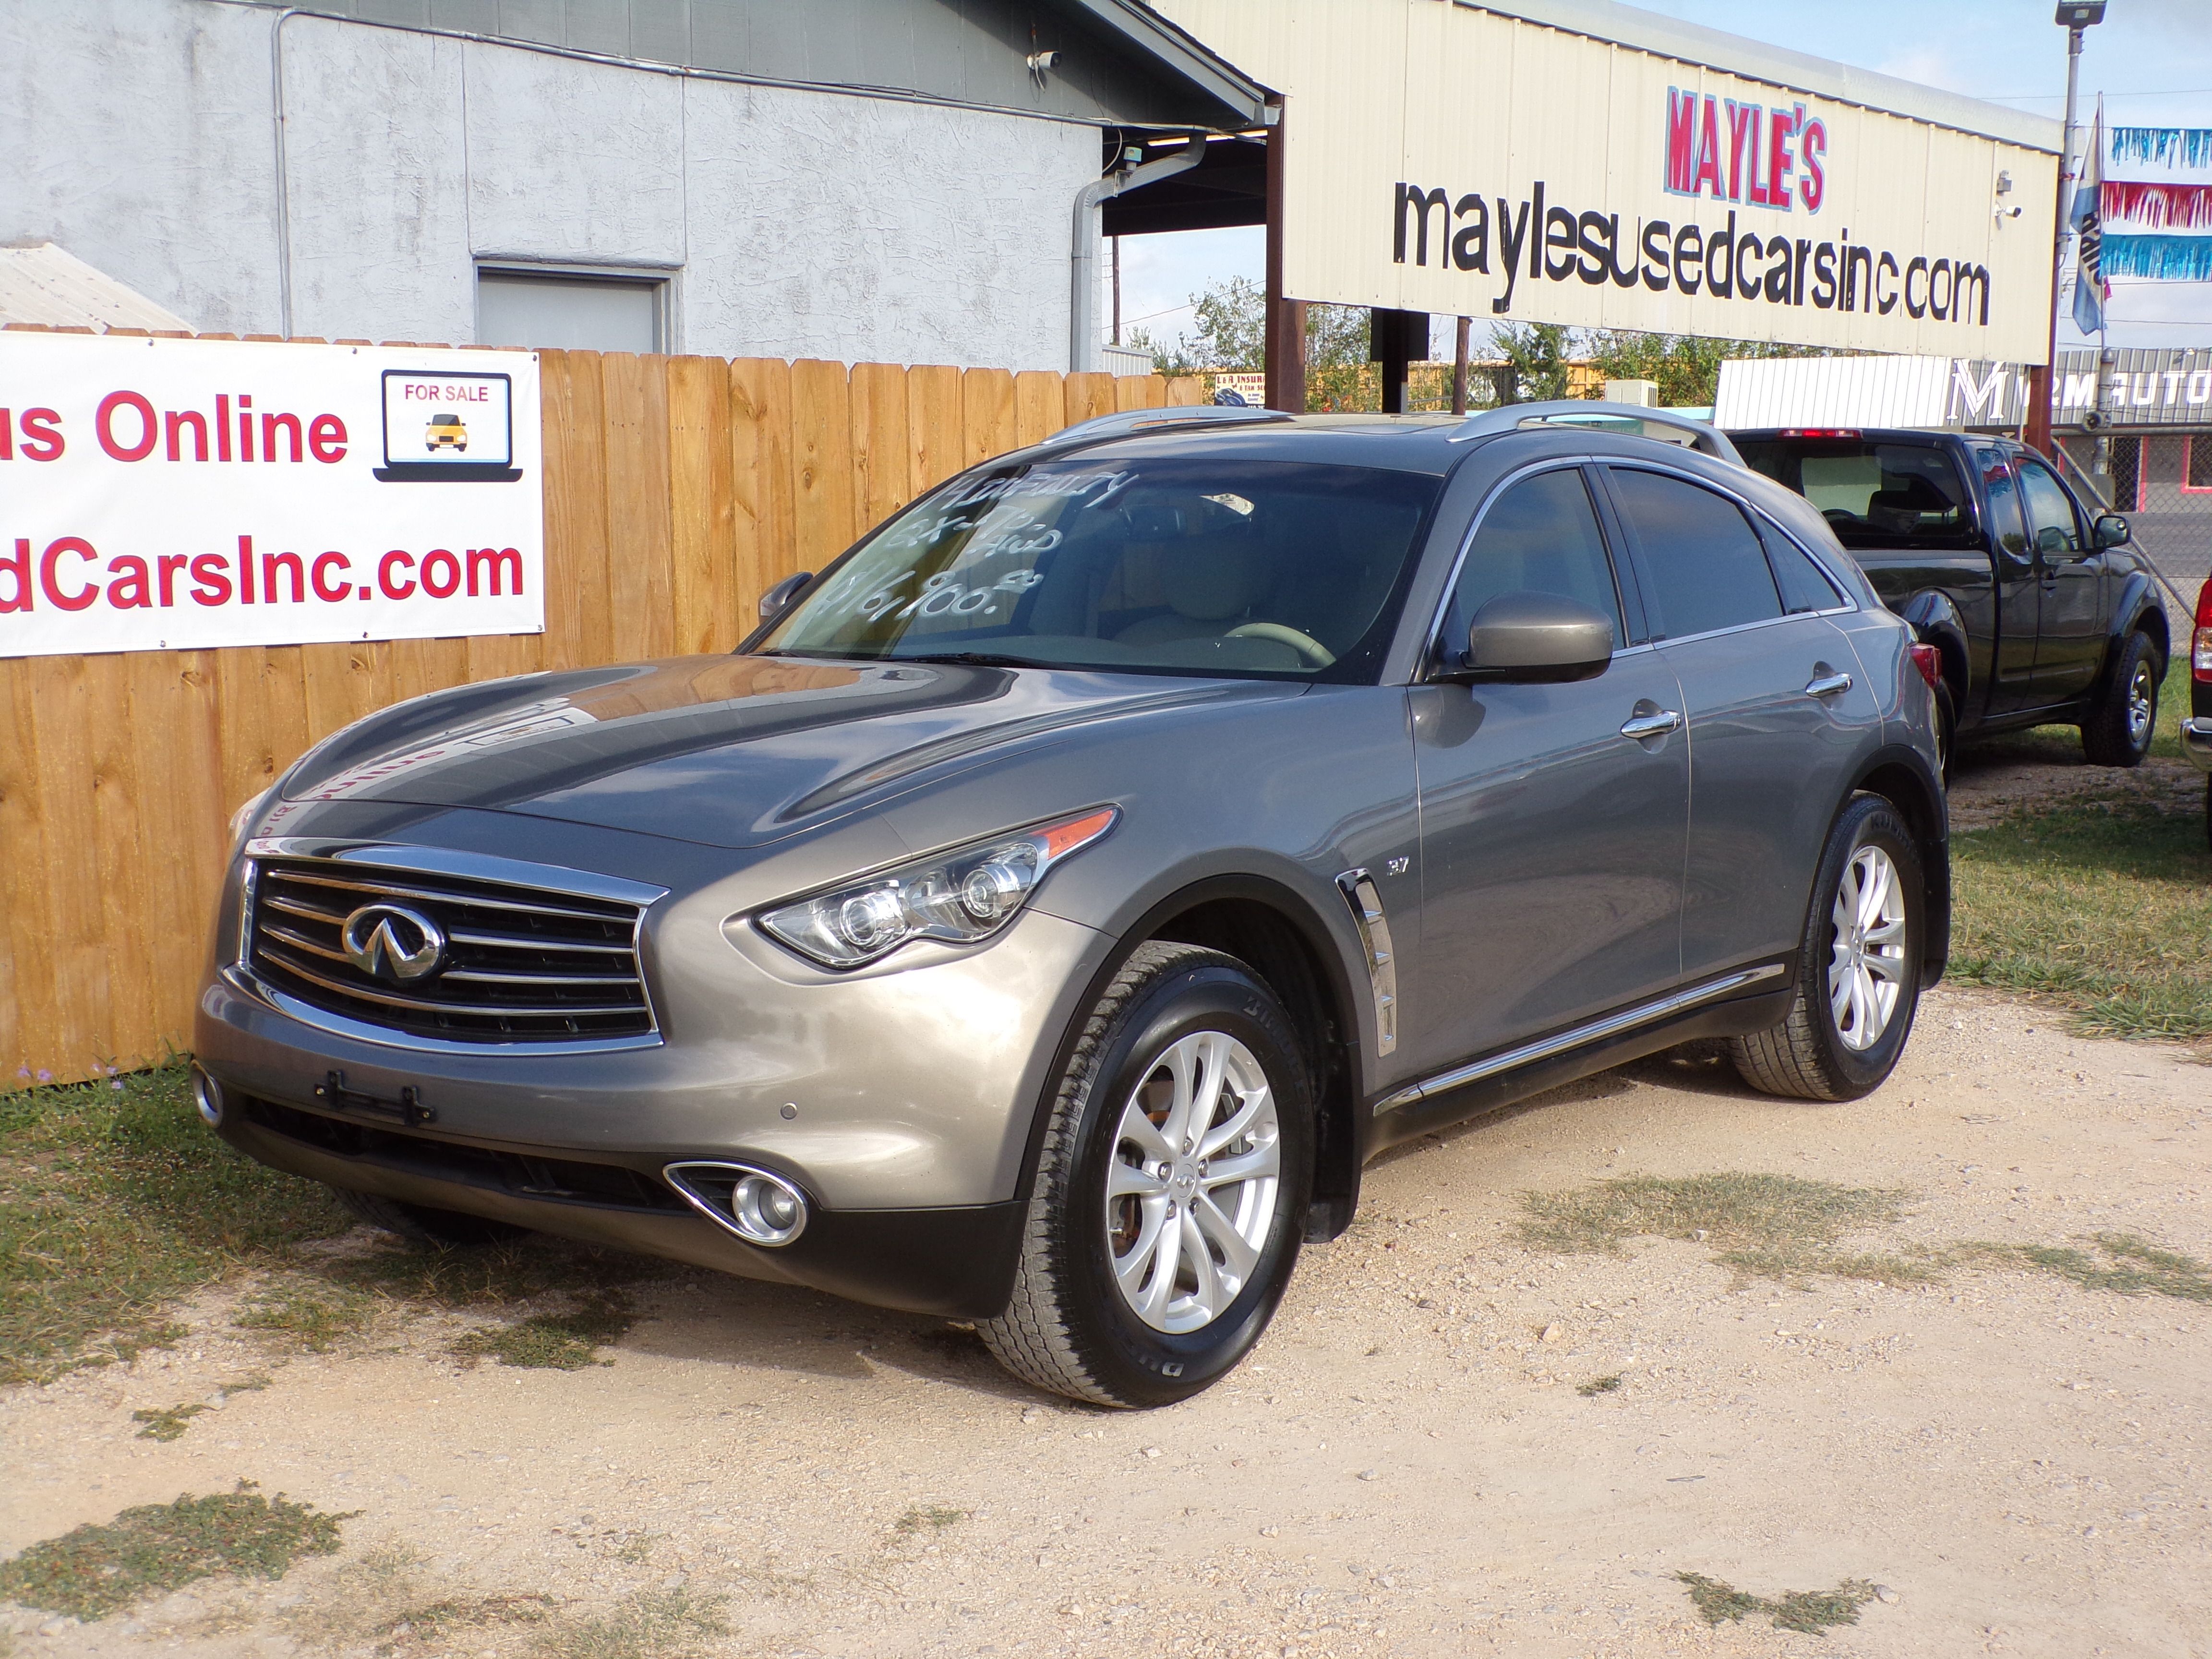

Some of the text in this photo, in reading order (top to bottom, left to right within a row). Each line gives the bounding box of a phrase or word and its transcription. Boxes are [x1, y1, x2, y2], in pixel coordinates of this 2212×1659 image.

[1664, 85, 1828, 215] MAYLE'S
[1393, 180, 1990, 326] maylesusedcarsinc.com
[405, 384, 489, 402] FOR SALE
[2112, 369, 2212, 406] AUTO
[96, 390, 348, 463] Online
[0, 535, 523, 613] dCarsInc.com
